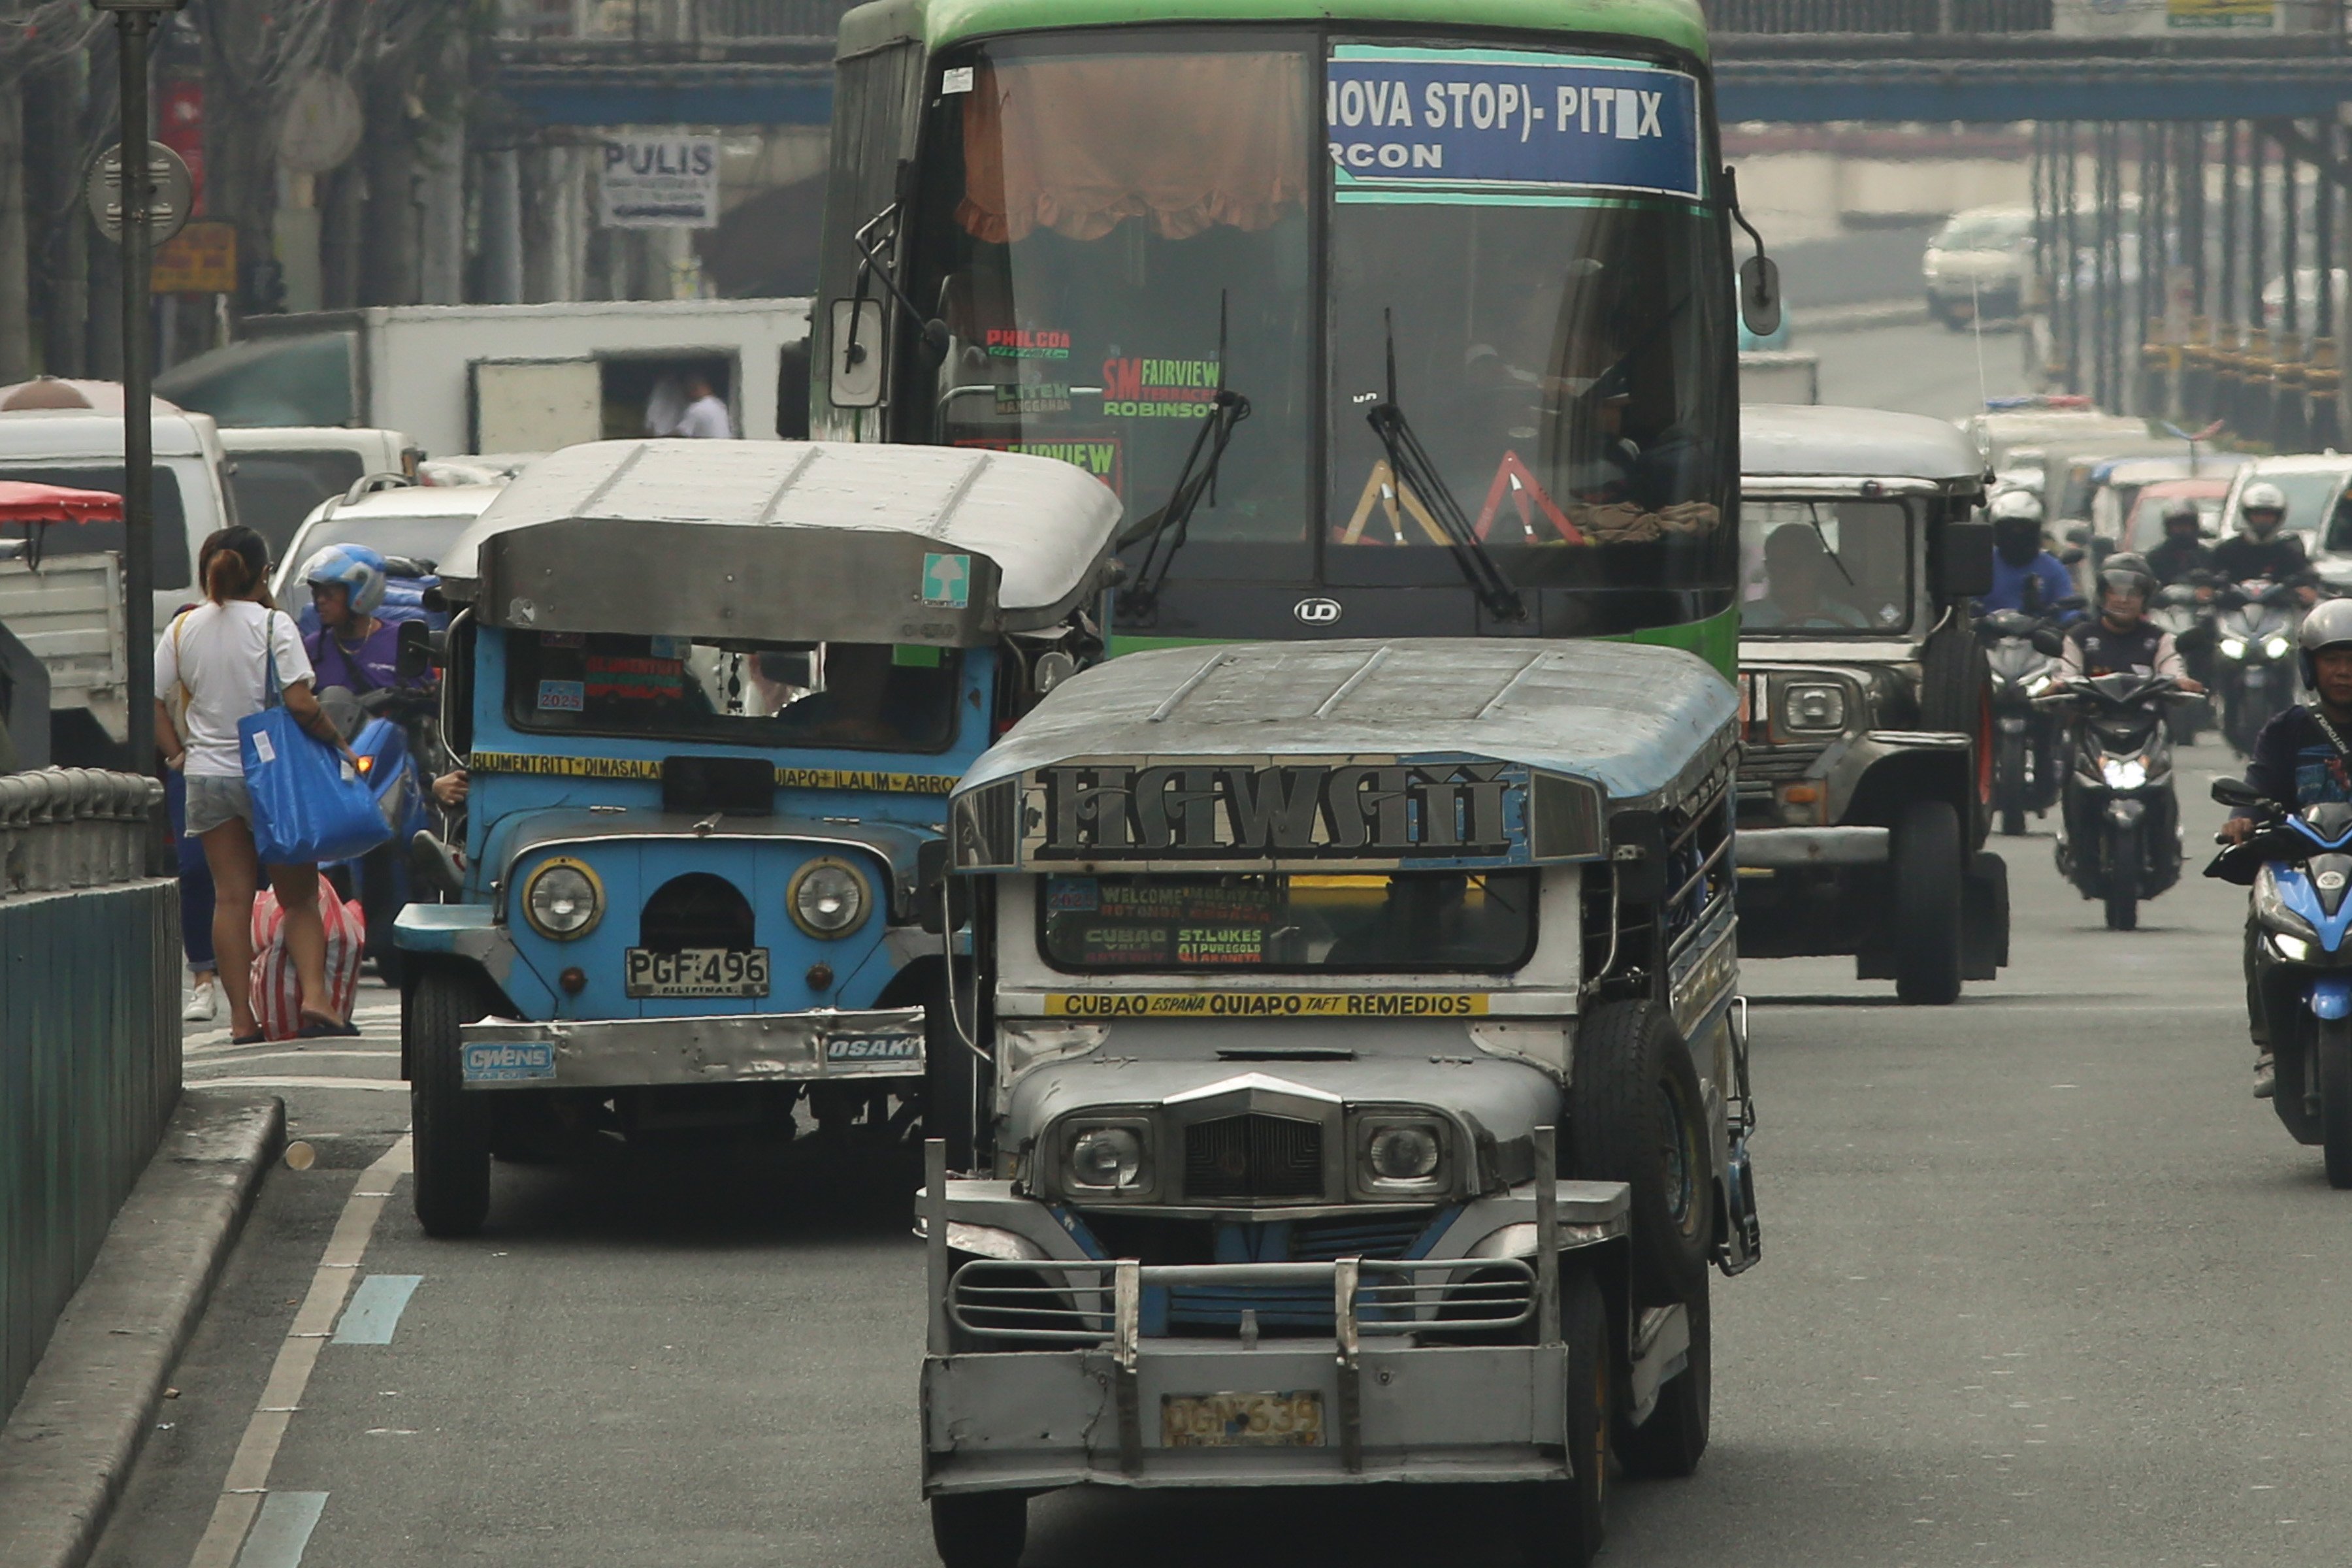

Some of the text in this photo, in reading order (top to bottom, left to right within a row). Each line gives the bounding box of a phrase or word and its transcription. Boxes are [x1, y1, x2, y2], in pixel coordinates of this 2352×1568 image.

[1558, 86, 1663, 139] PITX
[604, 140, 712, 175] PULIS
[987, 329, 1070, 348] PHILCOA
[1103, 357, 1142, 400] SM
[1142, 359, 1219, 387] FAIRVIEW
[1300, 604, 1337, 620] UD
[542, 694, 580, 708] 2025
[473, 753, 575, 774] BLUMENTRITT
[834, 770, 890, 791] ILALIM
[1102, 887, 1183, 905] WELCOME
[1085, 928, 1167, 942] CUBAO
[1200, 943, 1262, 954] PUREGOLD
[629, 953, 765, 983] PGF 496
[1064, 994, 1149, 1015] CUBAO
[1151, 994, 1207, 1012] ESPAÑA
[1209, 994, 1301, 1015] QUIAPO
[1306, 996, 1341, 1012] TAFT
[828, 1038, 917, 1057] OSAKI
